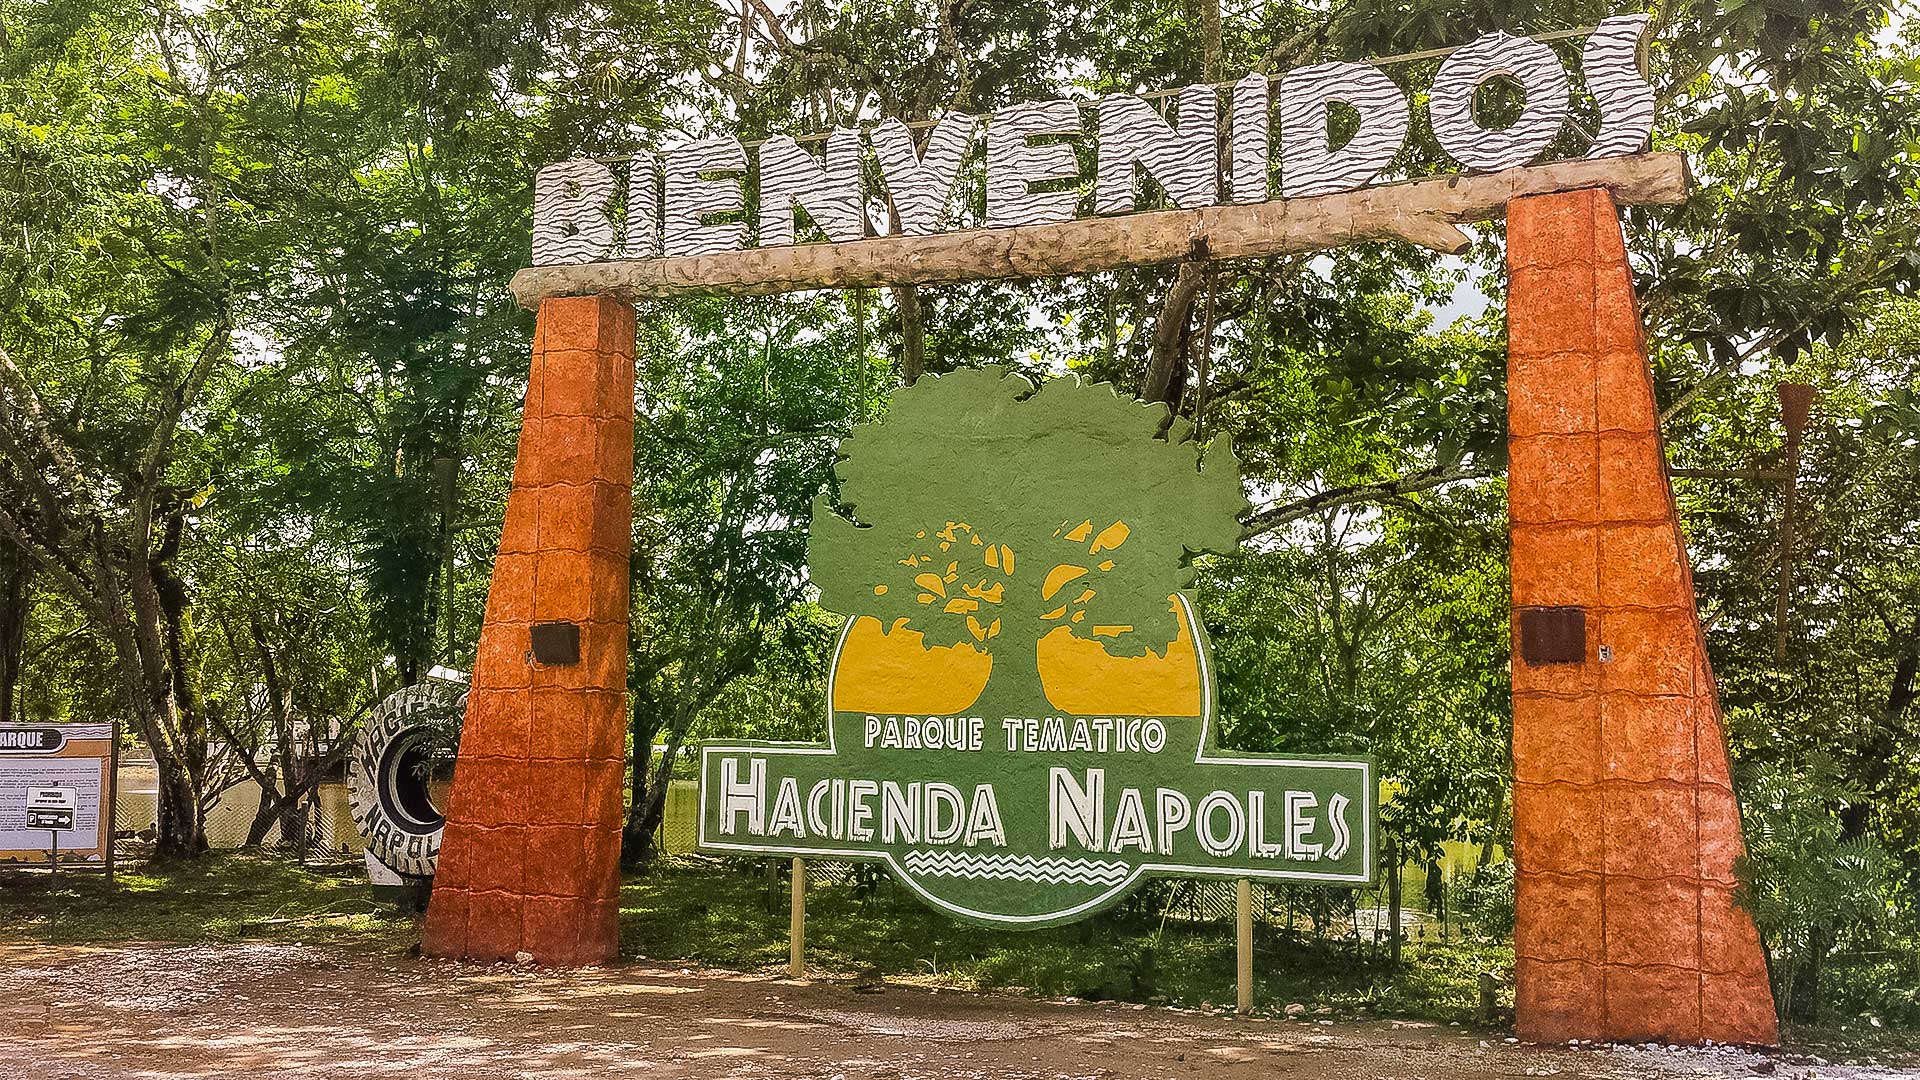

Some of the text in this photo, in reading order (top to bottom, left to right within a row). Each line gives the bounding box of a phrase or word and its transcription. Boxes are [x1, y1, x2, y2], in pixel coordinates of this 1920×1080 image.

[532, 13, 1656, 266] BIENVENIDOS
[864, 715, 1167, 753] PARQUE TEMATICO
[719, 757, 1353, 860] HACIENDA NAPOLES
